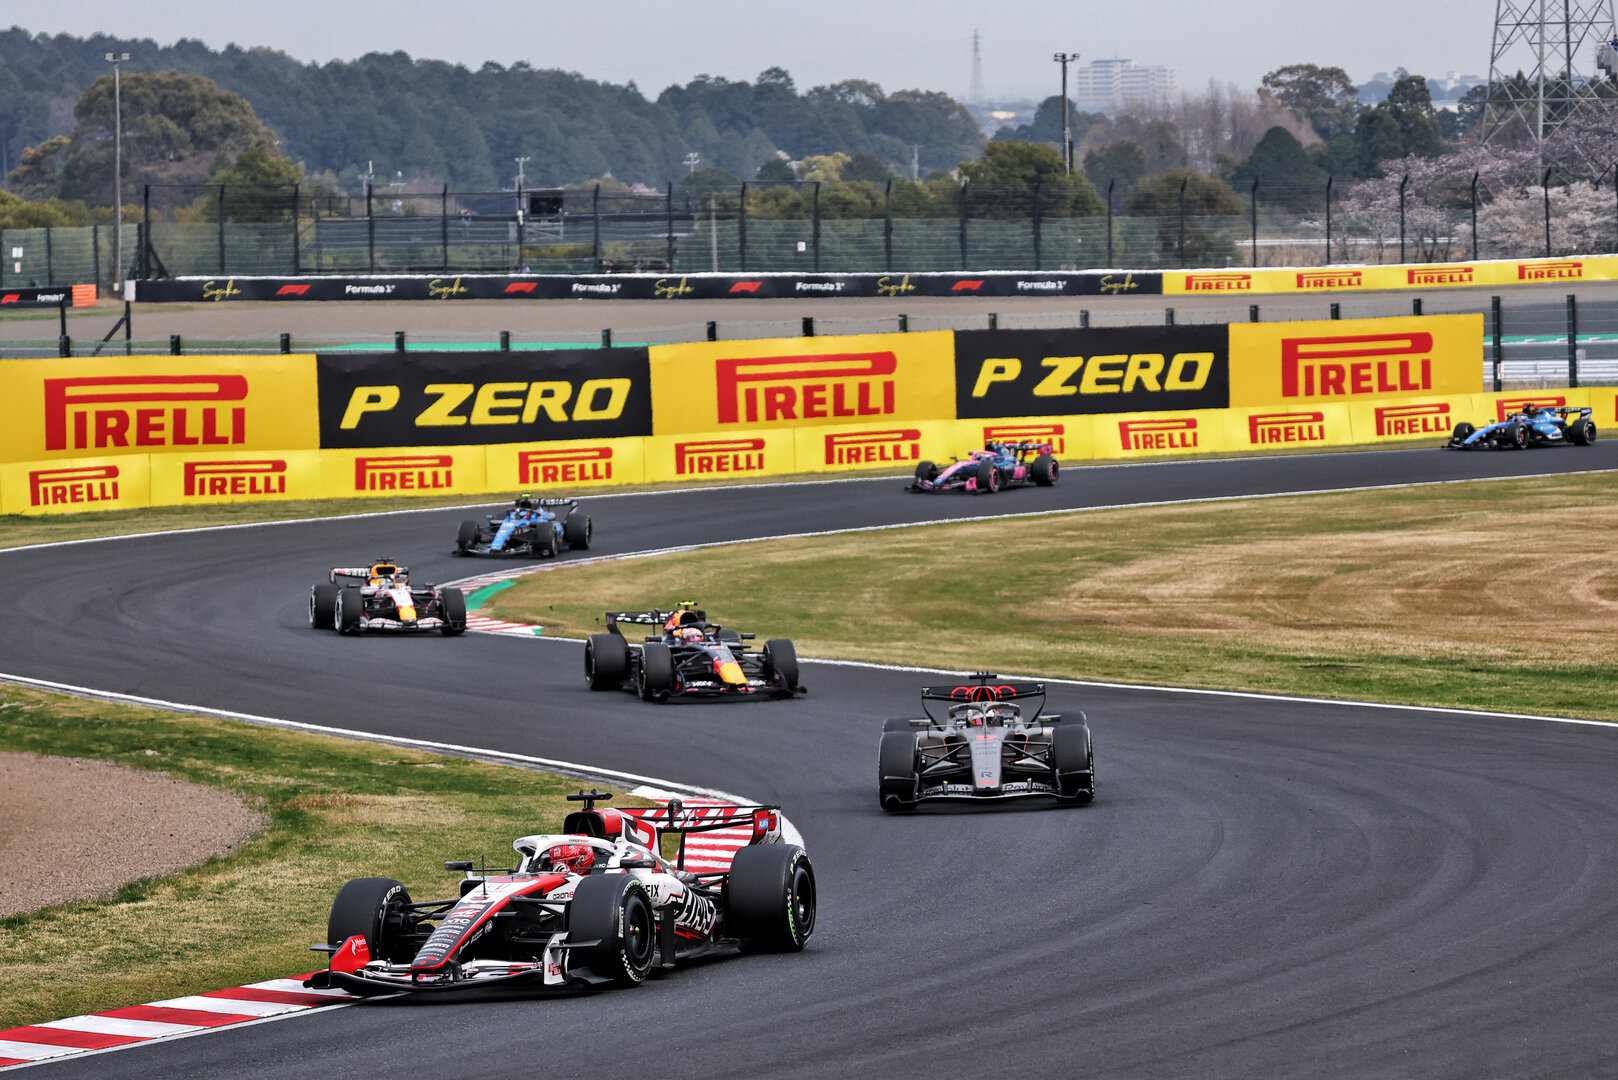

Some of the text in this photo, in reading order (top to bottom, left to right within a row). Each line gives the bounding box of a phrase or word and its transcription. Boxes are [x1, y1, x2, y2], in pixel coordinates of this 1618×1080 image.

[571, 283, 610, 293] Formula
[795, 282, 834, 292] Formula
[1017, 281, 1056, 290] Formula
[1185, 274, 1252, 291] PIRELLI
[1297, 271, 1362, 288] PIRELLI
[1408, 267, 1473, 284] PIRELLI
[1519, 262, 1583, 280] PIRELLI
[345, 285, 384, 294] Formula
[972, 352, 1215, 397] P ZERO
[1282, 332, 1434, 398] PIRELLI
[340, 379, 632, 429] P ZERO
[716, 351, 897, 424] PIRELLI
[44, 374, 249, 451] PIRELLI
[1249, 411, 1325, 444] PIRELLI
[1375, 403, 1451, 436] PIRELLI
[825, 429, 921, 465] PIRELLI
[1119, 418, 1198, 450] PIRELLI
[355, 455, 453, 490] PIRELLI
[518, 447, 613, 484] PIRELLI
[675, 438, 765, 475] PIRELLI
[29, 465, 119, 506] PIRELLI
[184, 459, 287, 496] PIRELLI
